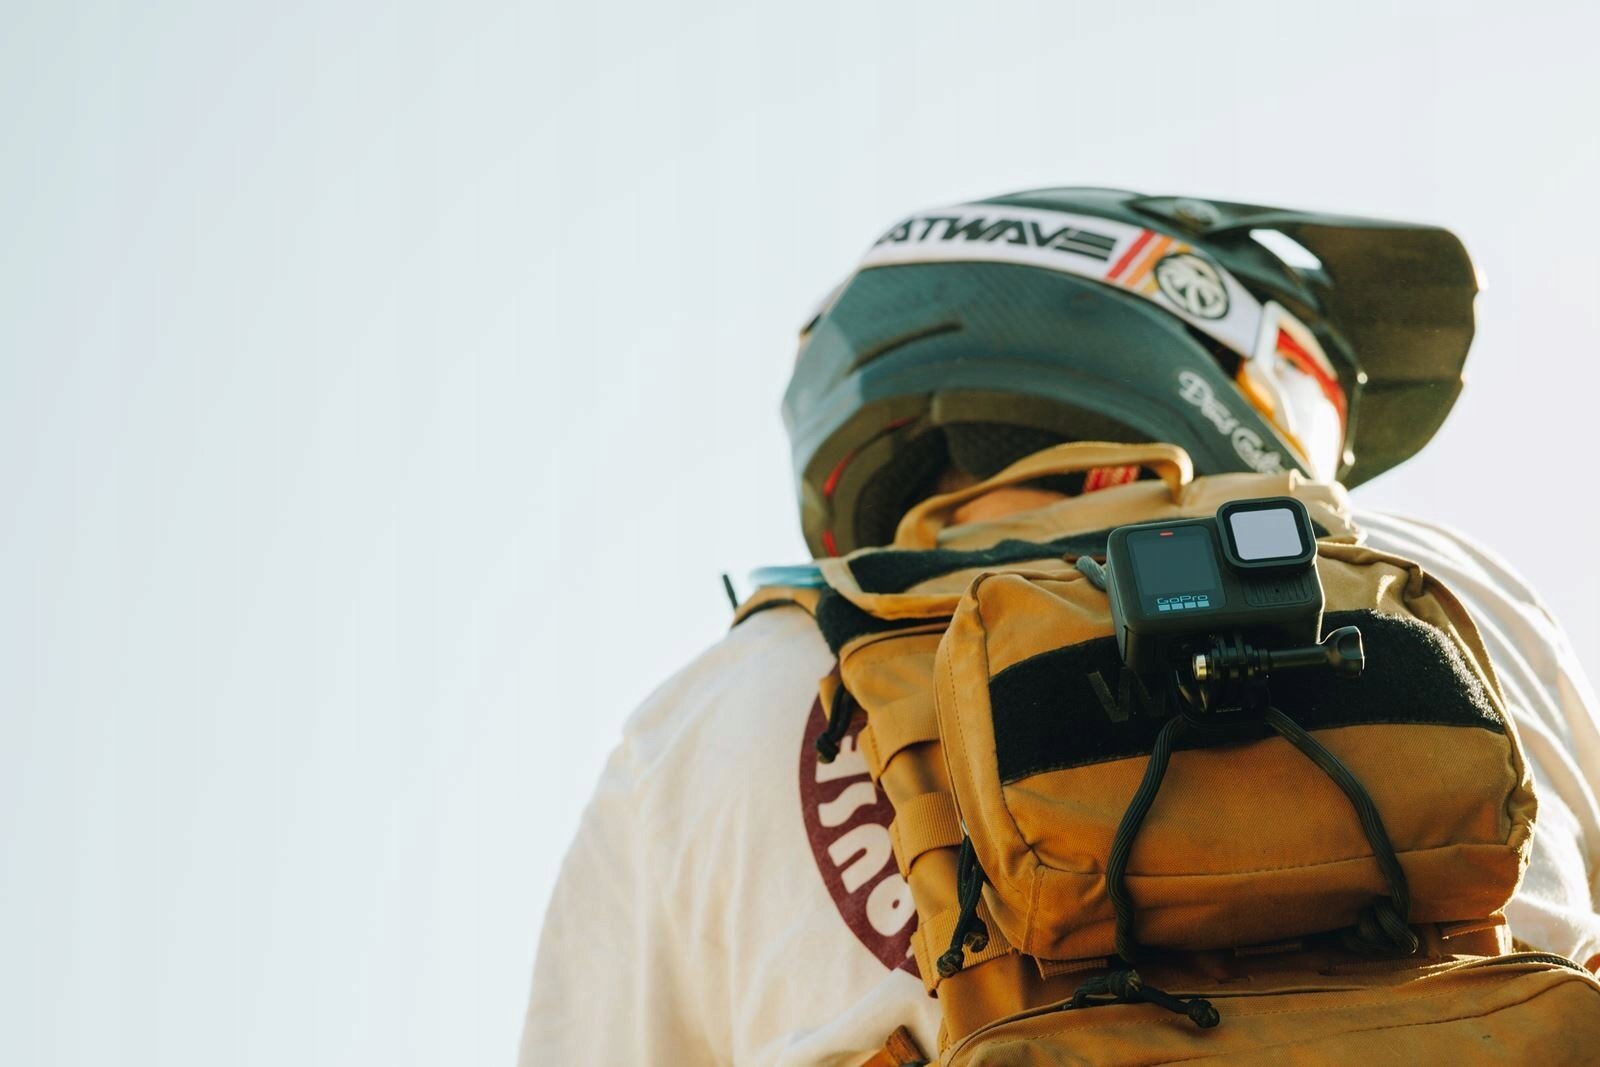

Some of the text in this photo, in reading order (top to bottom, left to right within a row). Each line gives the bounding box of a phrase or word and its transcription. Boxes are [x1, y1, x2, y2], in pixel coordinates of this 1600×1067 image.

[876, 217, 1118, 261] ATWAVE
[1157, 594, 1208, 605] GoPro
[815, 733, 917, 958] OUSE
